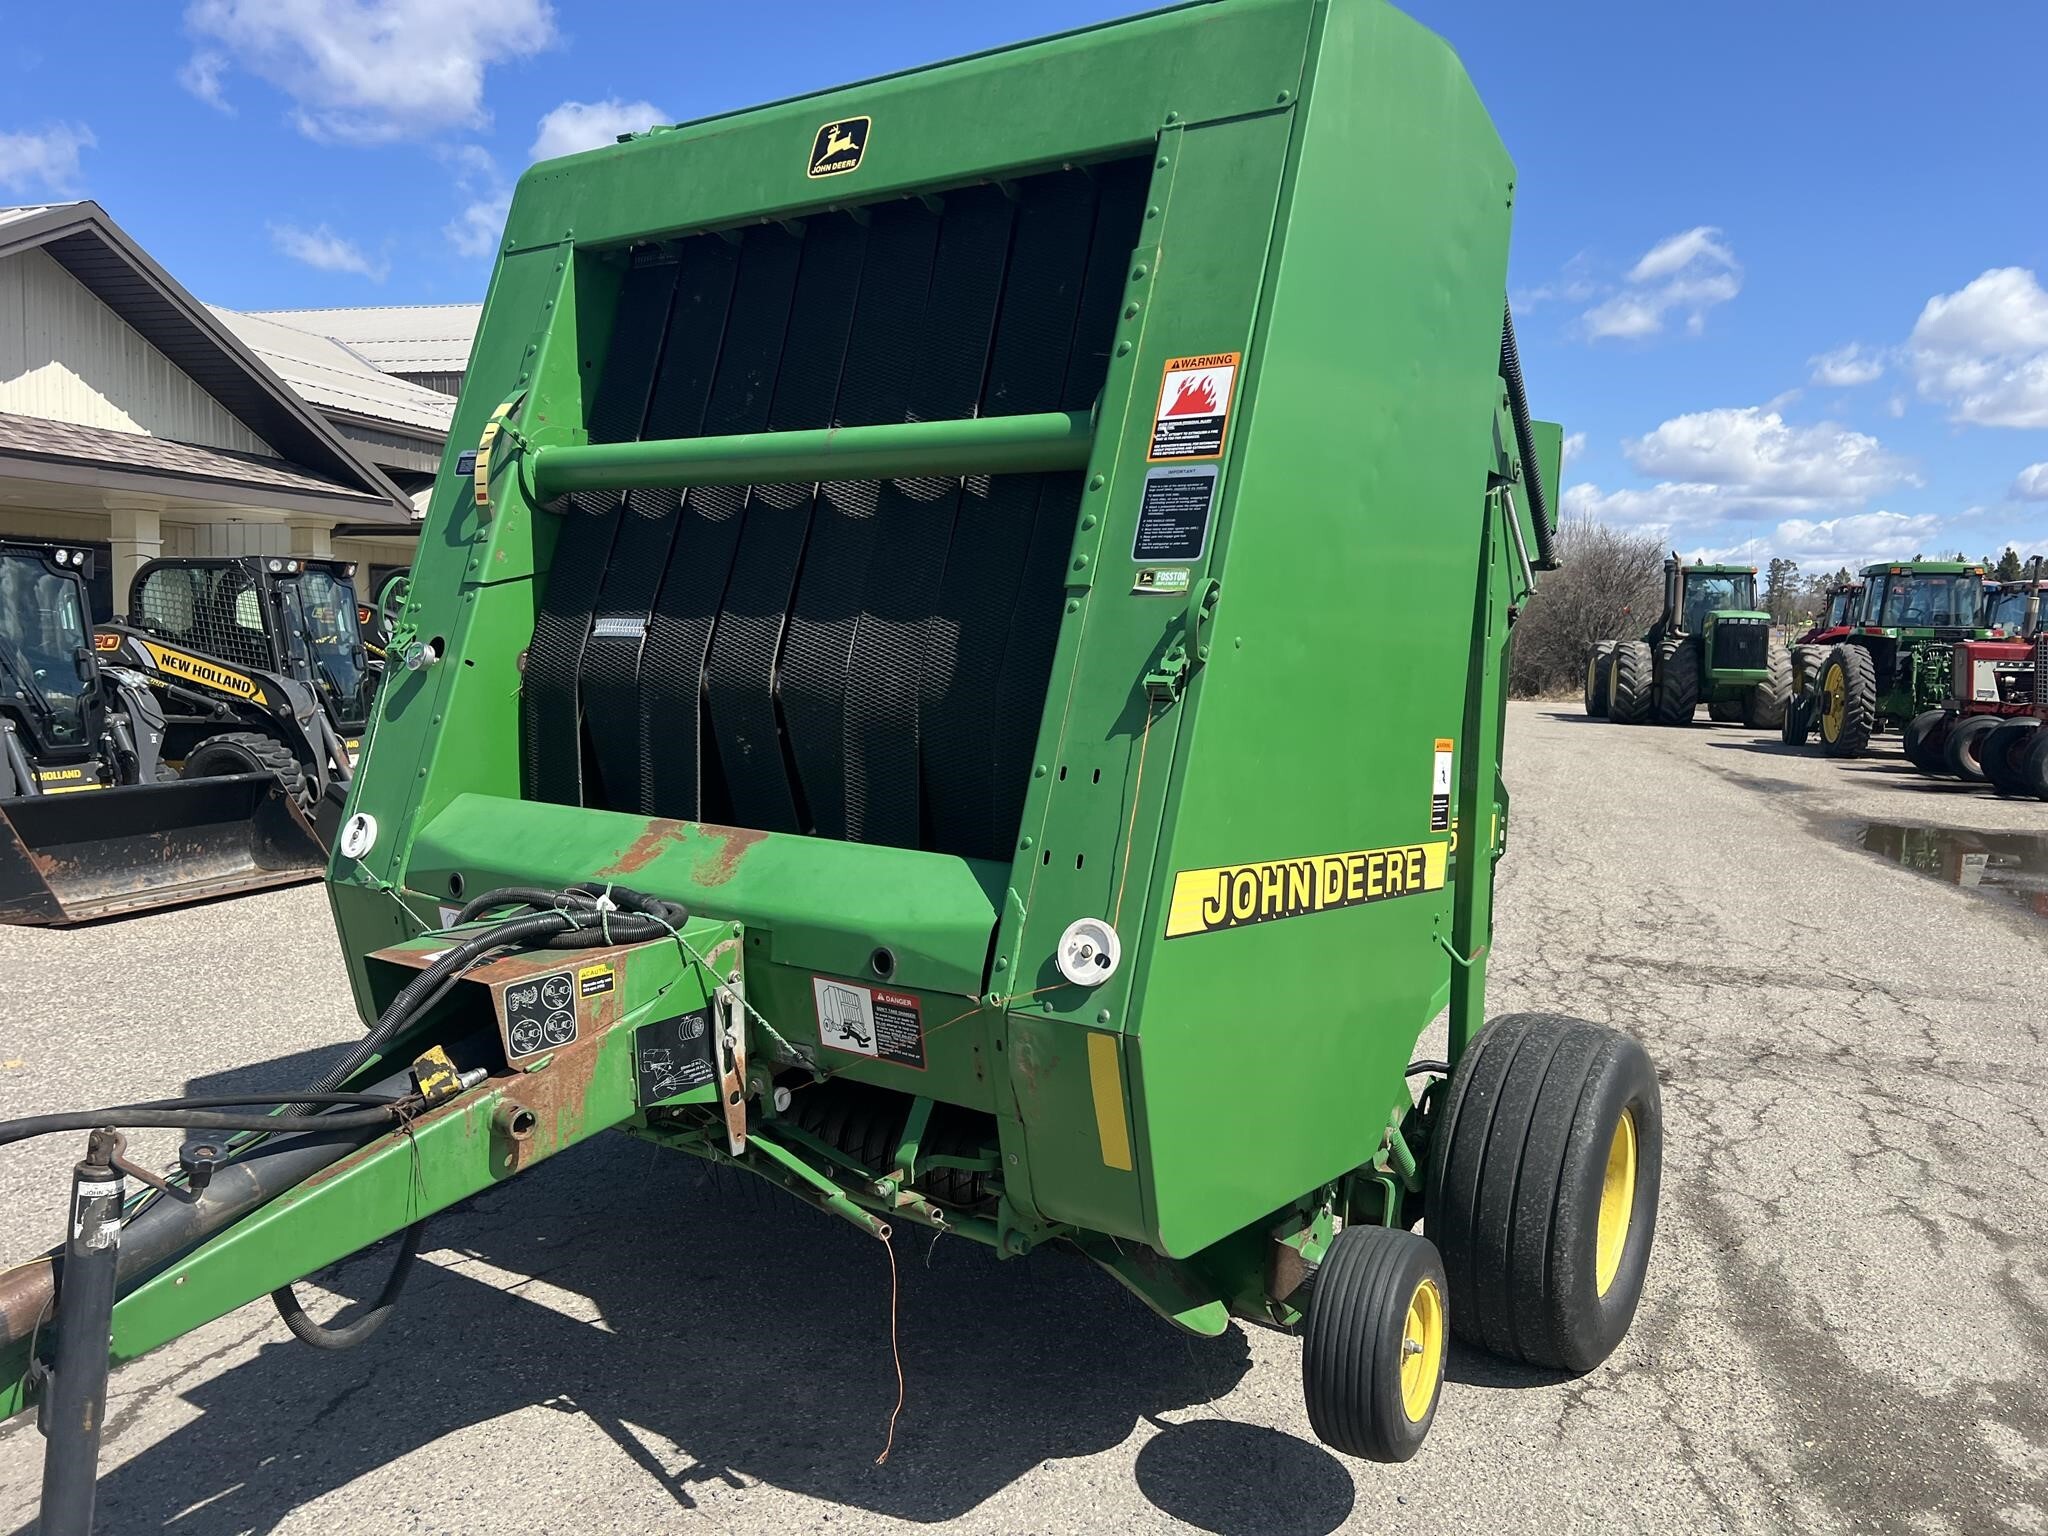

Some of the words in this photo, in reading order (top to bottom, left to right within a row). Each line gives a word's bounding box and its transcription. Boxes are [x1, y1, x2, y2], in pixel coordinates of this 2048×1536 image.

[811, 163, 831, 174] JOHN
[832, 158, 857, 170] DEERE
[1181, 354, 1233, 369] WARNING
[1156, 571, 1187, 581] FOSSTON
[161, 653, 190, 673] NEW
[192, 664, 251, 694] HOLLAND
[40, 769, 81, 781] HOLLAND
[1203, 862, 1314, 927] JOHN
[1323, 848, 1424, 905] DEERE
[586, 967, 608, 977] CAUTIO
[885, 995, 912, 1006] DANGER
